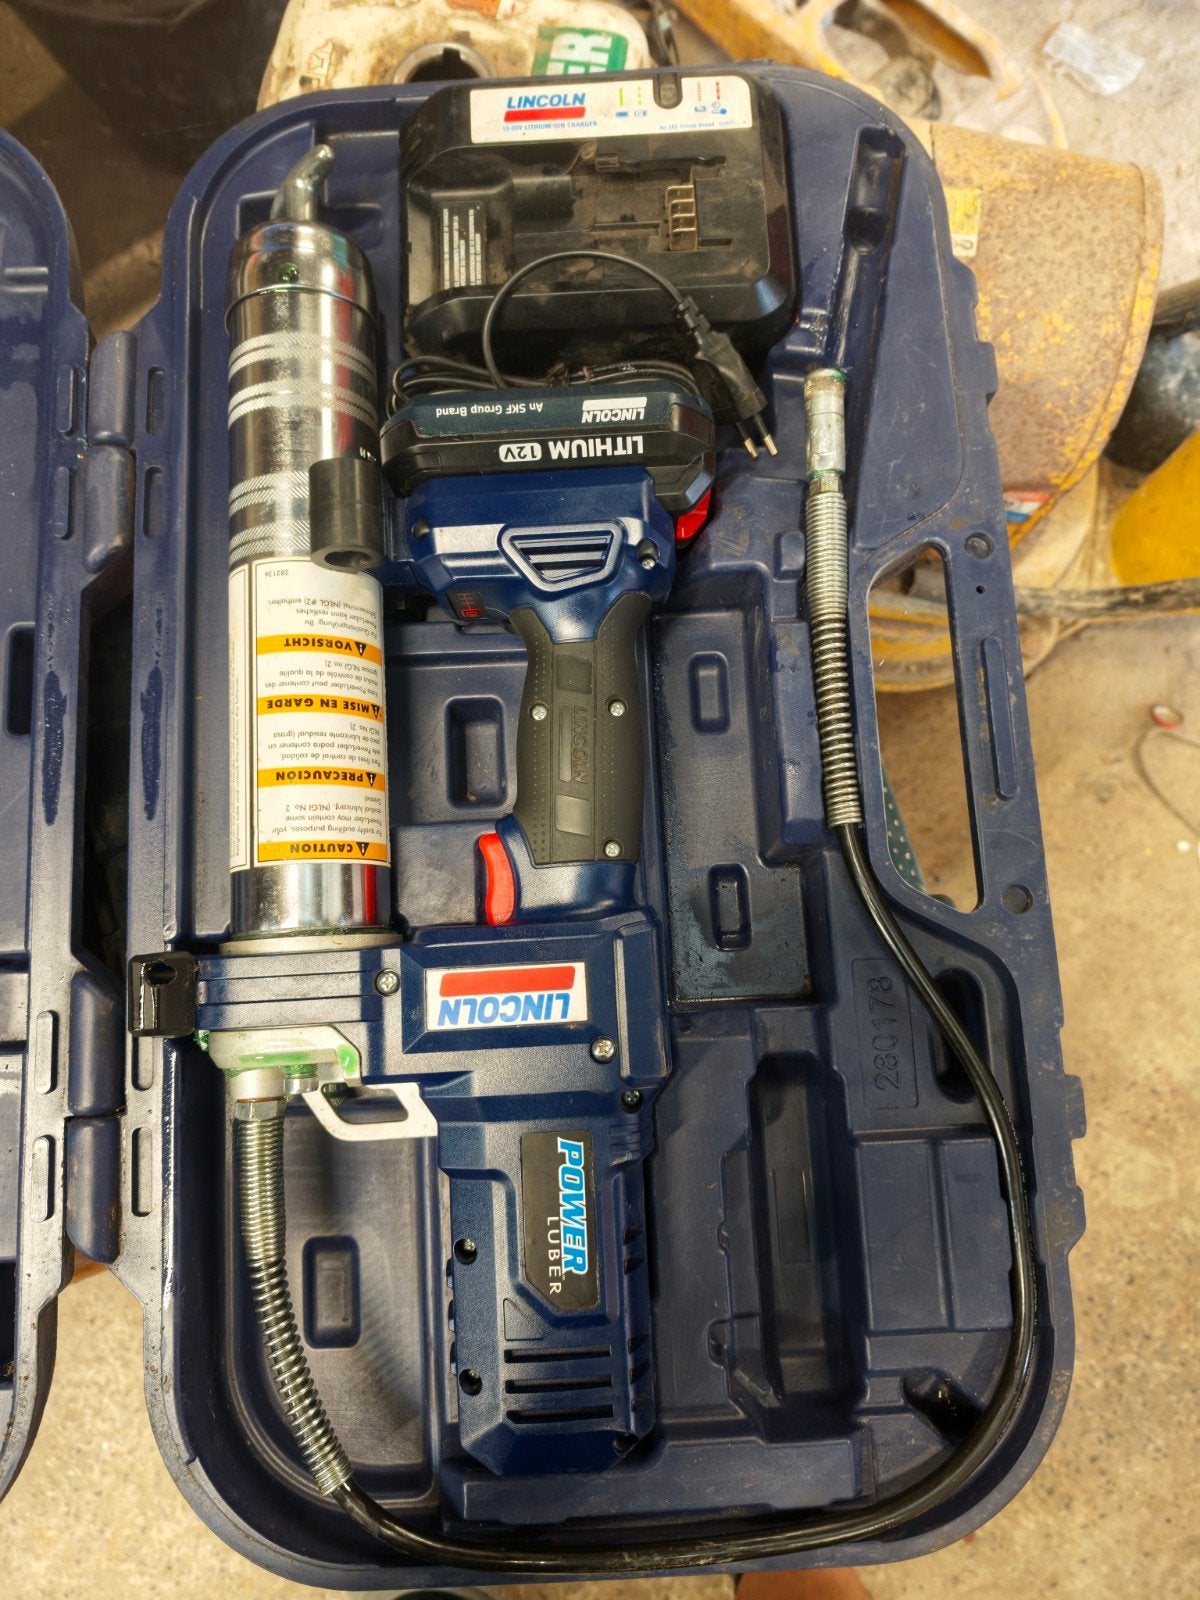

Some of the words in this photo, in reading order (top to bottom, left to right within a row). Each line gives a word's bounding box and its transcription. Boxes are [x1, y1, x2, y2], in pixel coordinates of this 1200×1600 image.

[506, 92, 587, 110] LINCOLN
[502, 124, 523, 132] 12-20V
[567, 120, 598, 128] CHARGER
[435, 406, 467, 419] Brand
[470, 403, 502, 417] Group
[504, 403, 526, 418] SKF
[528, 402, 544, 413] An
[581, 407, 645, 424] LINCOLN
[502, 444, 540, 461] 12V
[547, 435, 644, 460] LITHIUM
[295, 608, 329, 616] restliches
[330, 611, 348, 620] kann
[284, 637, 353, 651] VORSICHT
[324, 659, 332, 668] 2)
[344, 662, 360, 672] NLGI
[305, 669, 313, 677] la
[354, 675, 363, 683] de
[264, 682, 277, 690] des
[278, 680, 310, 689] contener
[311, 680, 328, 689] peut
[330, 682, 366, 694] PowerLuber
[266, 698, 314, 710] GARDE
[319, 698, 338, 709] EN
[342, 700, 370, 714] MISE
[297, 731, 327, 740] residual
[329, 731, 361, 743] lubricante
[278, 741, 311, 750] contener
[572, 705, 589, 785] LINCOLN
[310, 752, 320, 760] de
[322, 753, 347, 761] control
[348, 754, 357, 763] de
[357, 756, 371, 765] fines
[275, 770, 364, 784] PRECAUCIÓN
[285, 804, 290, 812] 2
[294, 804, 307, 812] No.
[308, 802, 331, 812] (NLGI
[307, 814, 336, 822] contain
[337, 814, 352, 823] may
[327, 825, 356, 834] auditing
[289, 843, 353, 853] CAUTION
[436, 992, 571, 1027] LINCOLN
[866, 976, 901, 1091] 280178
[556, 1136, 589, 1277] POWER
[546, 1215, 562, 1295] LUBER
